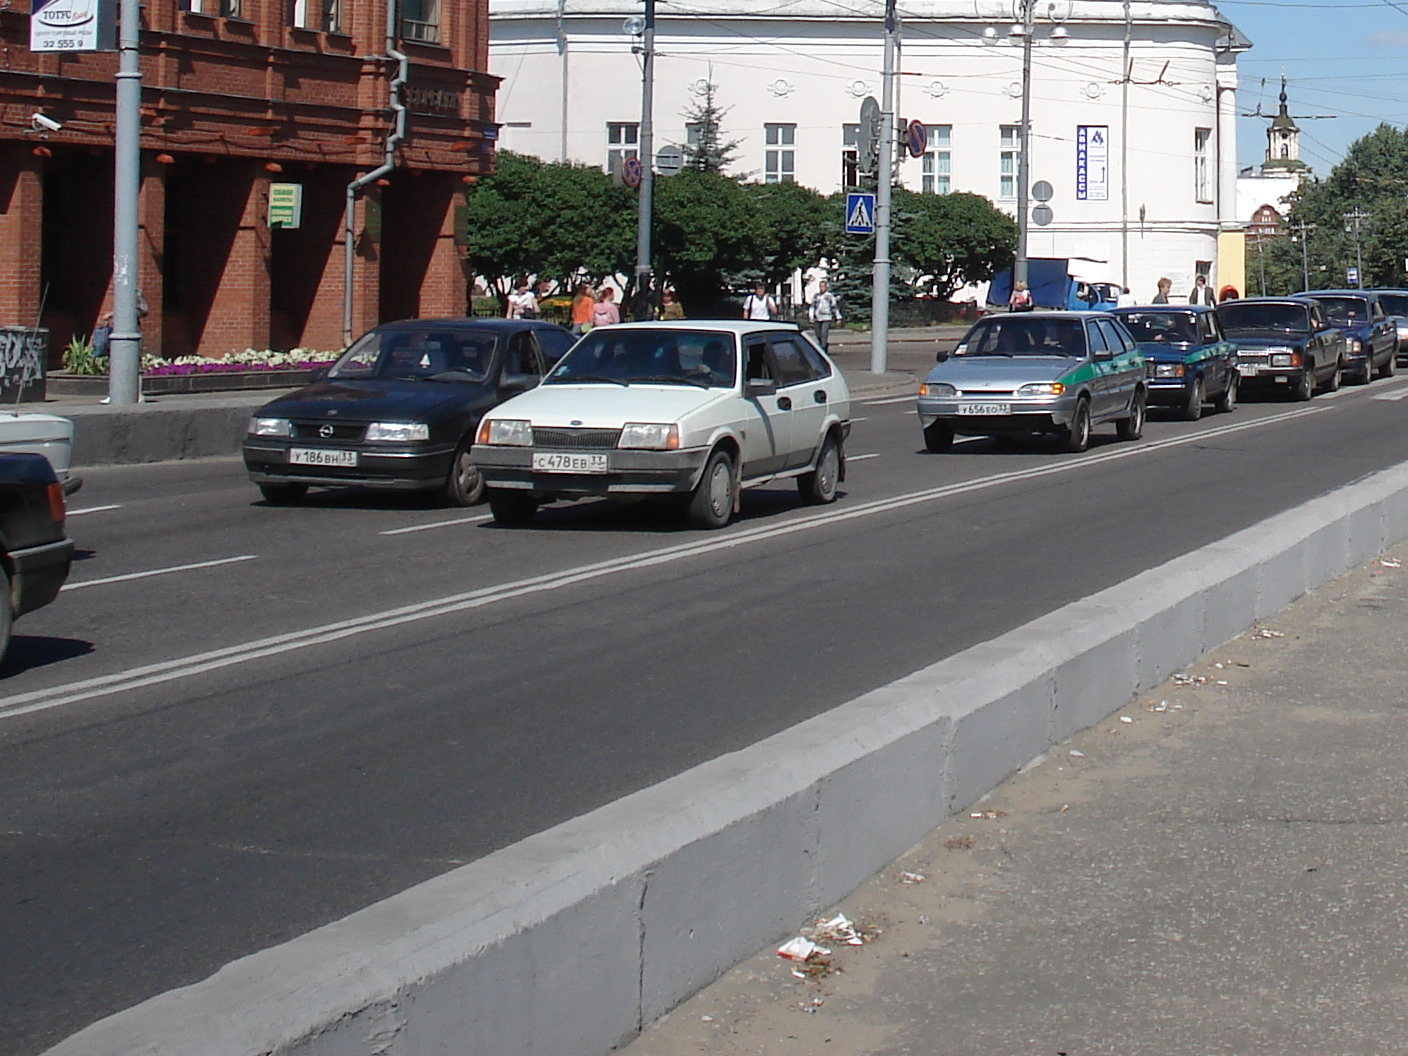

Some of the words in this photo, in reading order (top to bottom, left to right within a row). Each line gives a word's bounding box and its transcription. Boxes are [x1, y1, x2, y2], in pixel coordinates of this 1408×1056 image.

[43, 10, 72, 20] ТОТУС
[44, 40, 55, 48] 32
[57, 39, 75, 49] 555
[77, 40, 84, 48] 9
[1078, 128, 1087, 199] АВИАКАССЫ
